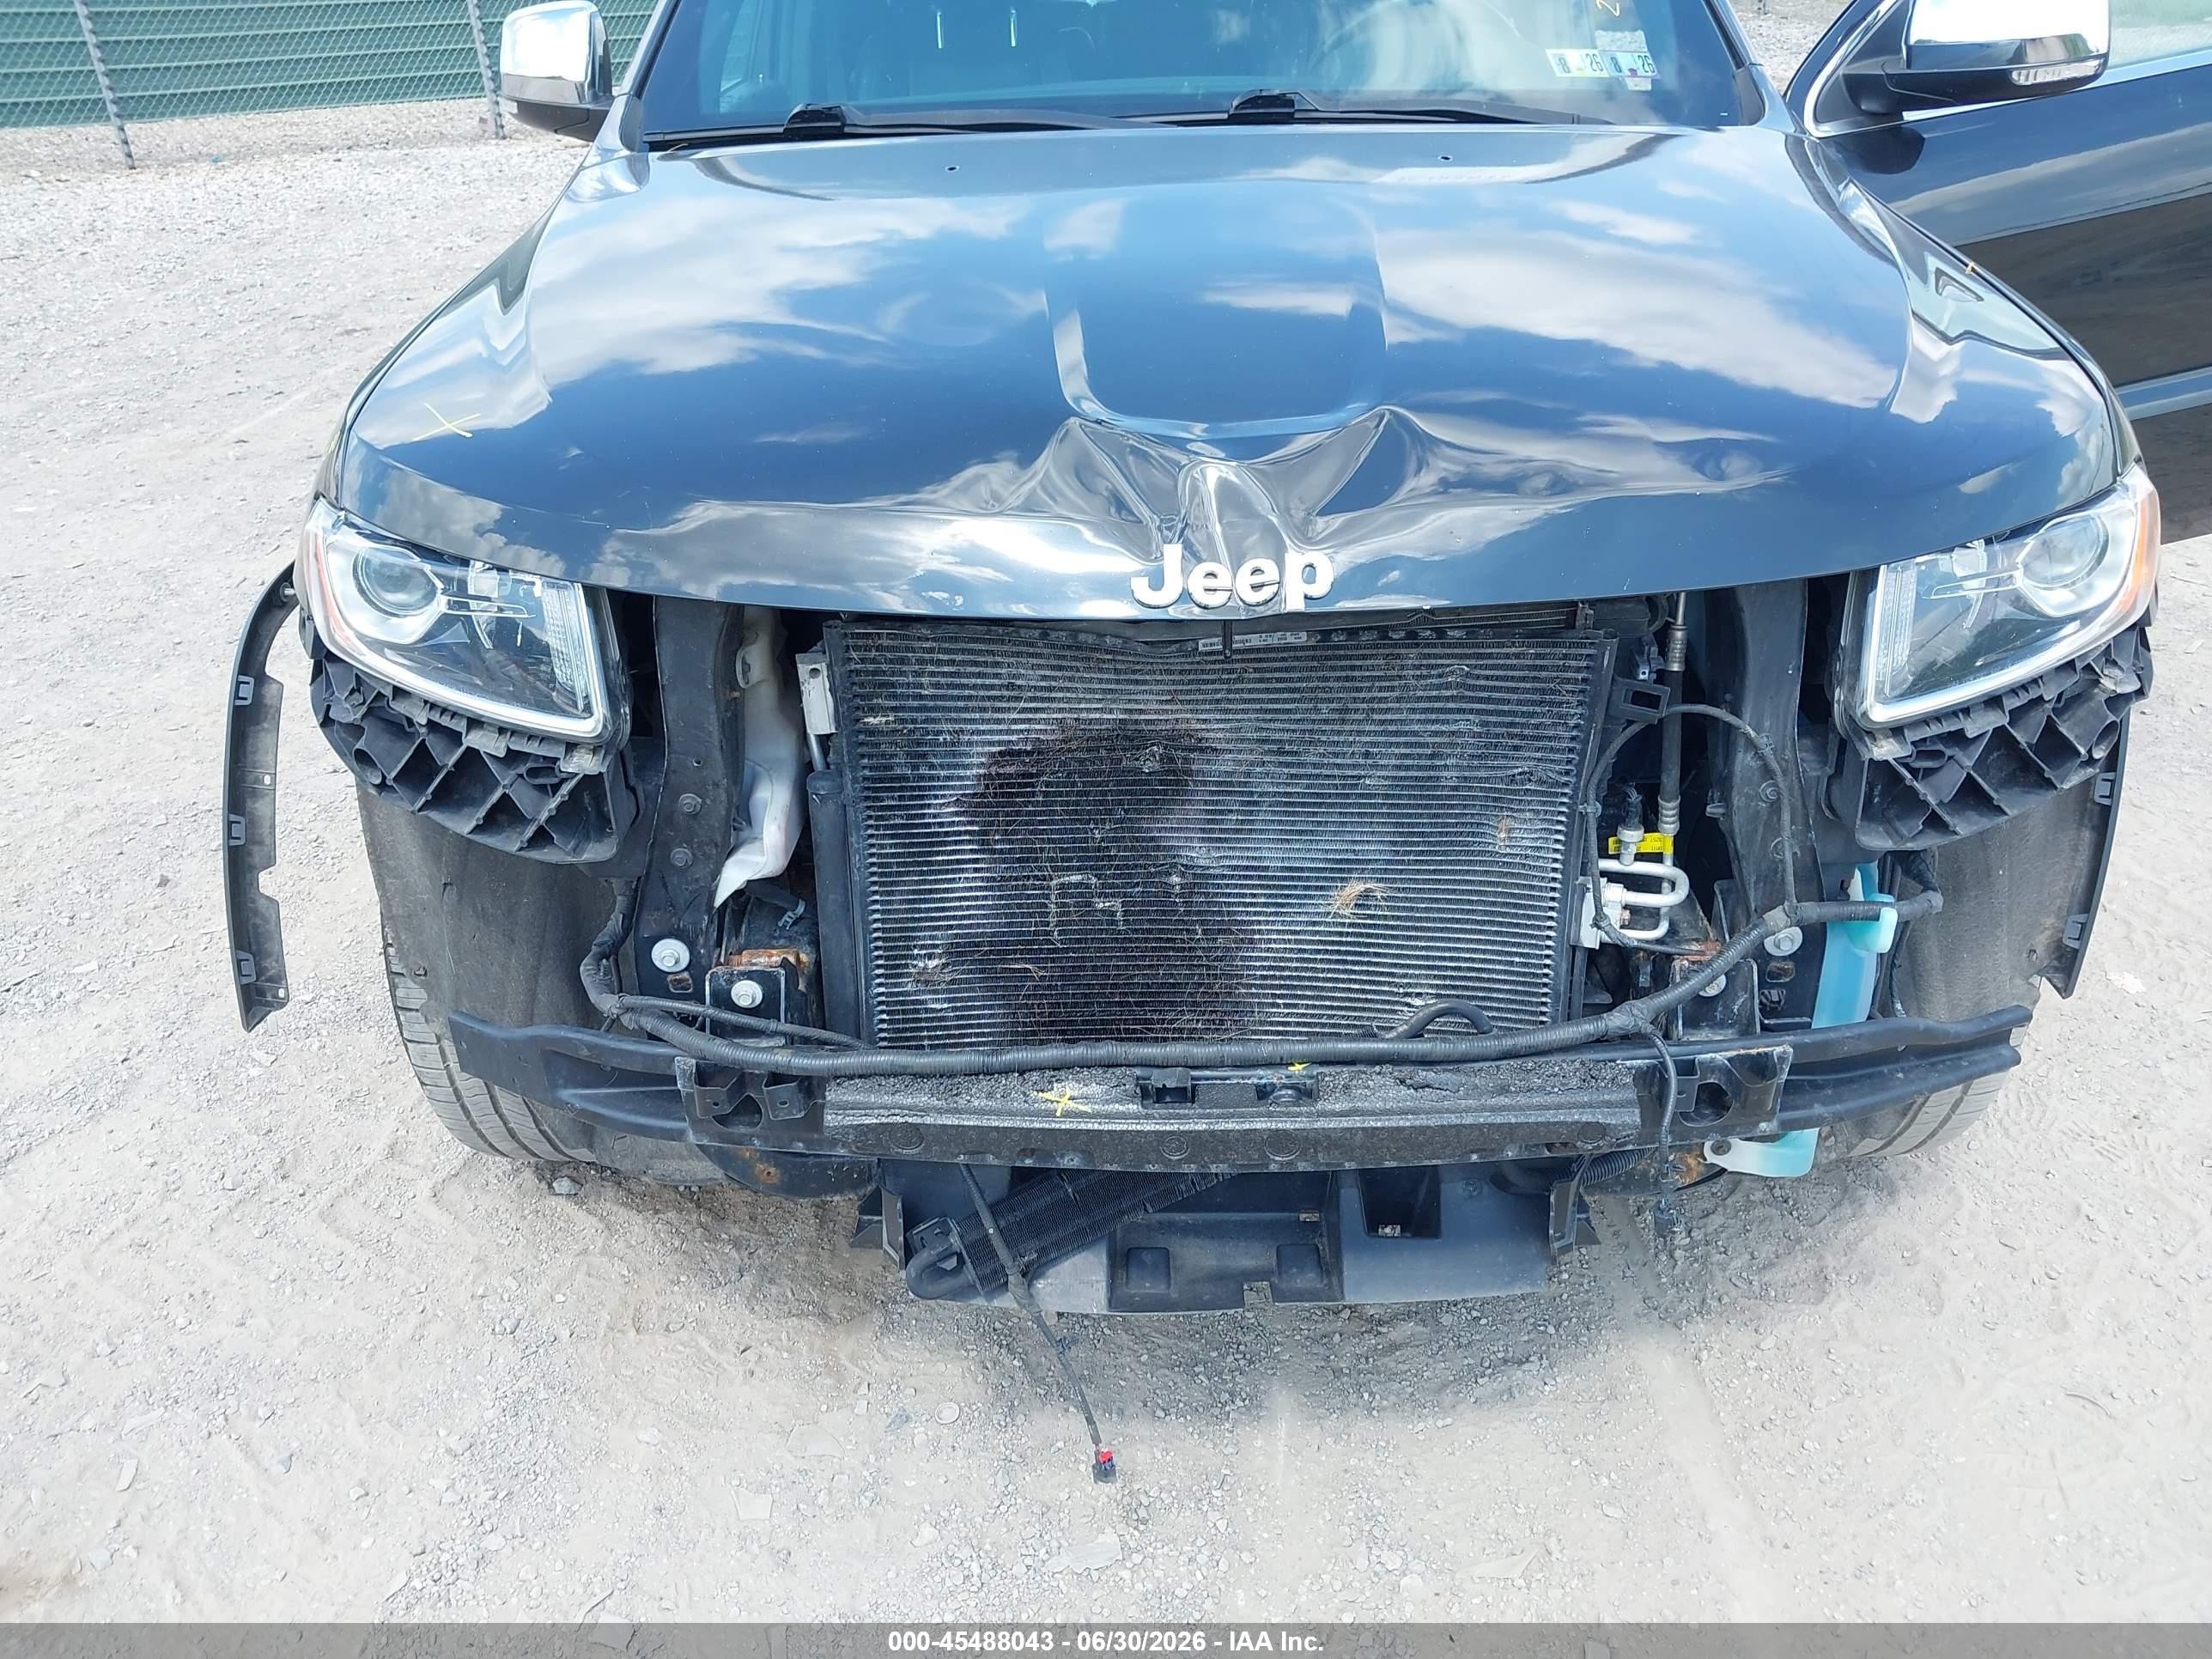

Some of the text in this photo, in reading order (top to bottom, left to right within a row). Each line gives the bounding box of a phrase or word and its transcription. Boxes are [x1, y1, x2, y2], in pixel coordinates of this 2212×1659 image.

[1585, 53, 1604, 72] 26
[1610, 54, 1656, 74] 8 26
[1129, 543, 1334, 612] Jeep
